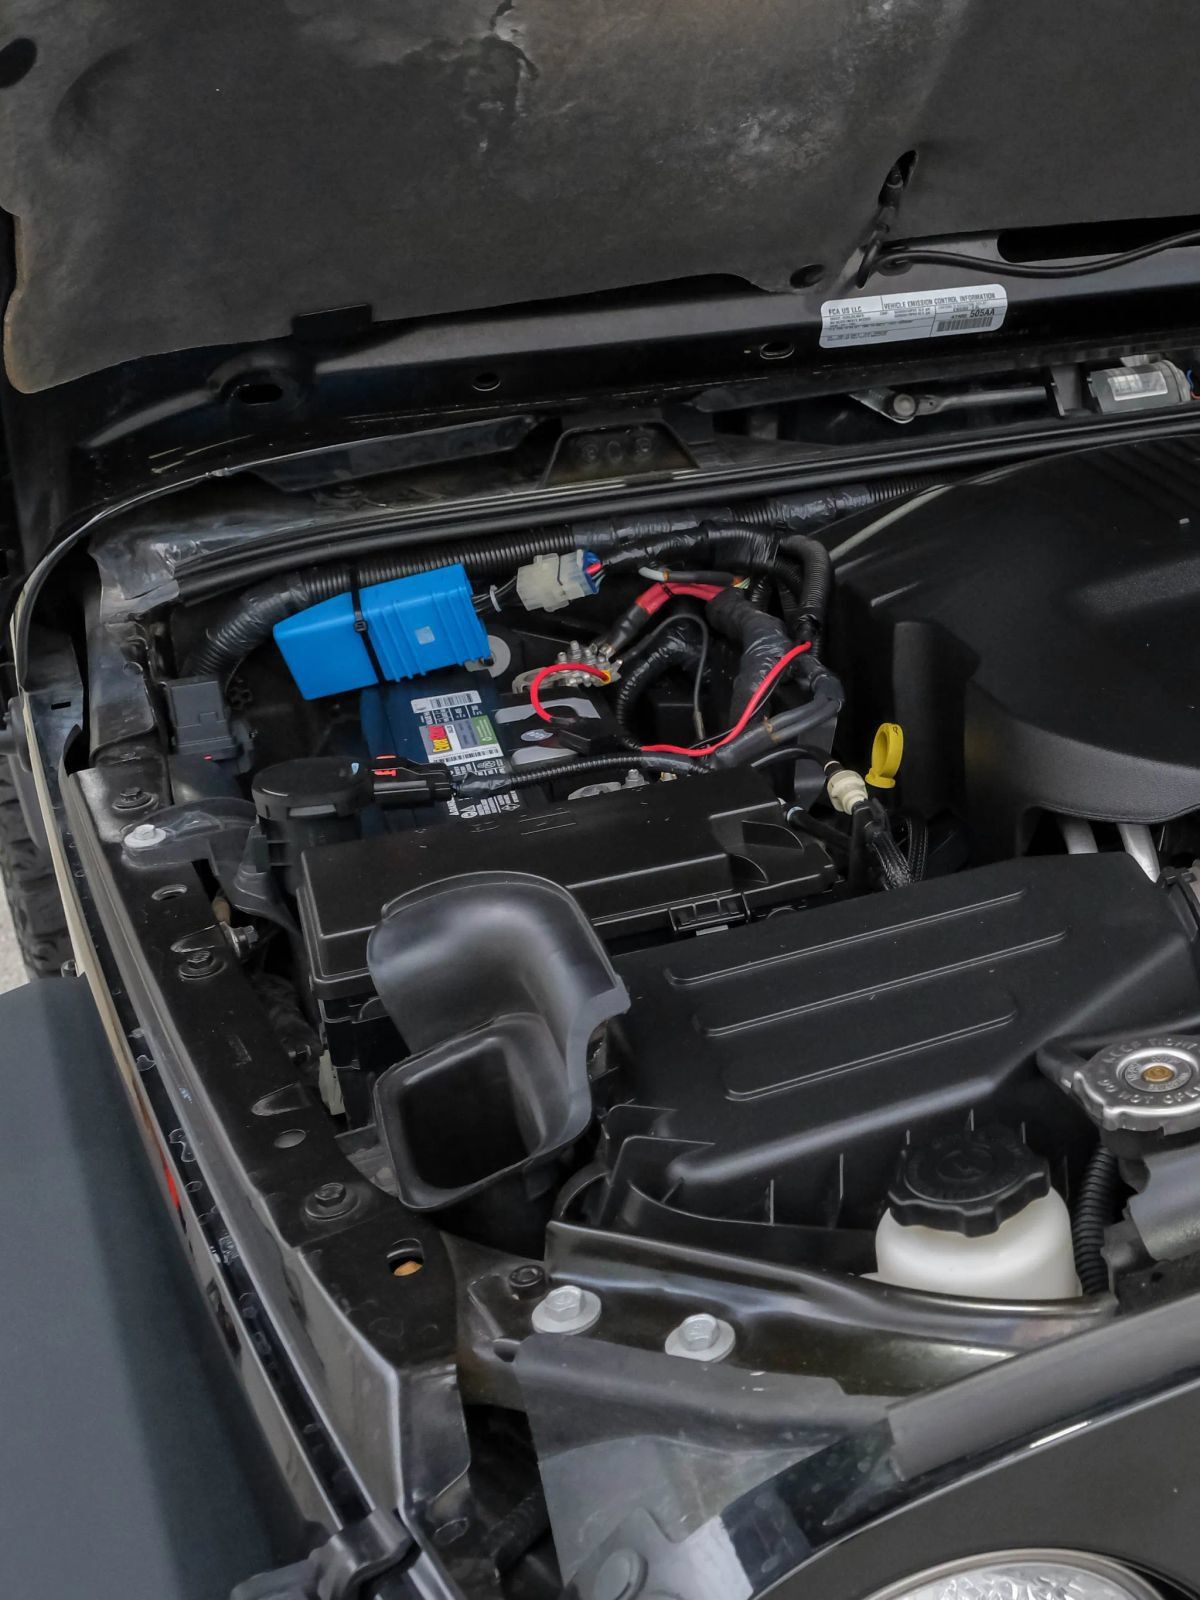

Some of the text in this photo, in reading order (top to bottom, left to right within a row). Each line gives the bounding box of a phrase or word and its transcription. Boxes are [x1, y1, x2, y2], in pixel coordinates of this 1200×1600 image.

[883, 301, 906, 310] VEHICLE
[907, 299, 934, 308] EMISSION
[934, 297, 957, 306] CONTROL
[959, 293, 996, 302] INFORMATION
[969, 309, 995, 318] 505AA
[1148, 1038, 1198, 1050] TIGHT
[1097, 1079, 1118, 1093] DO
[1118, 1091, 1154, 1103] NOT
